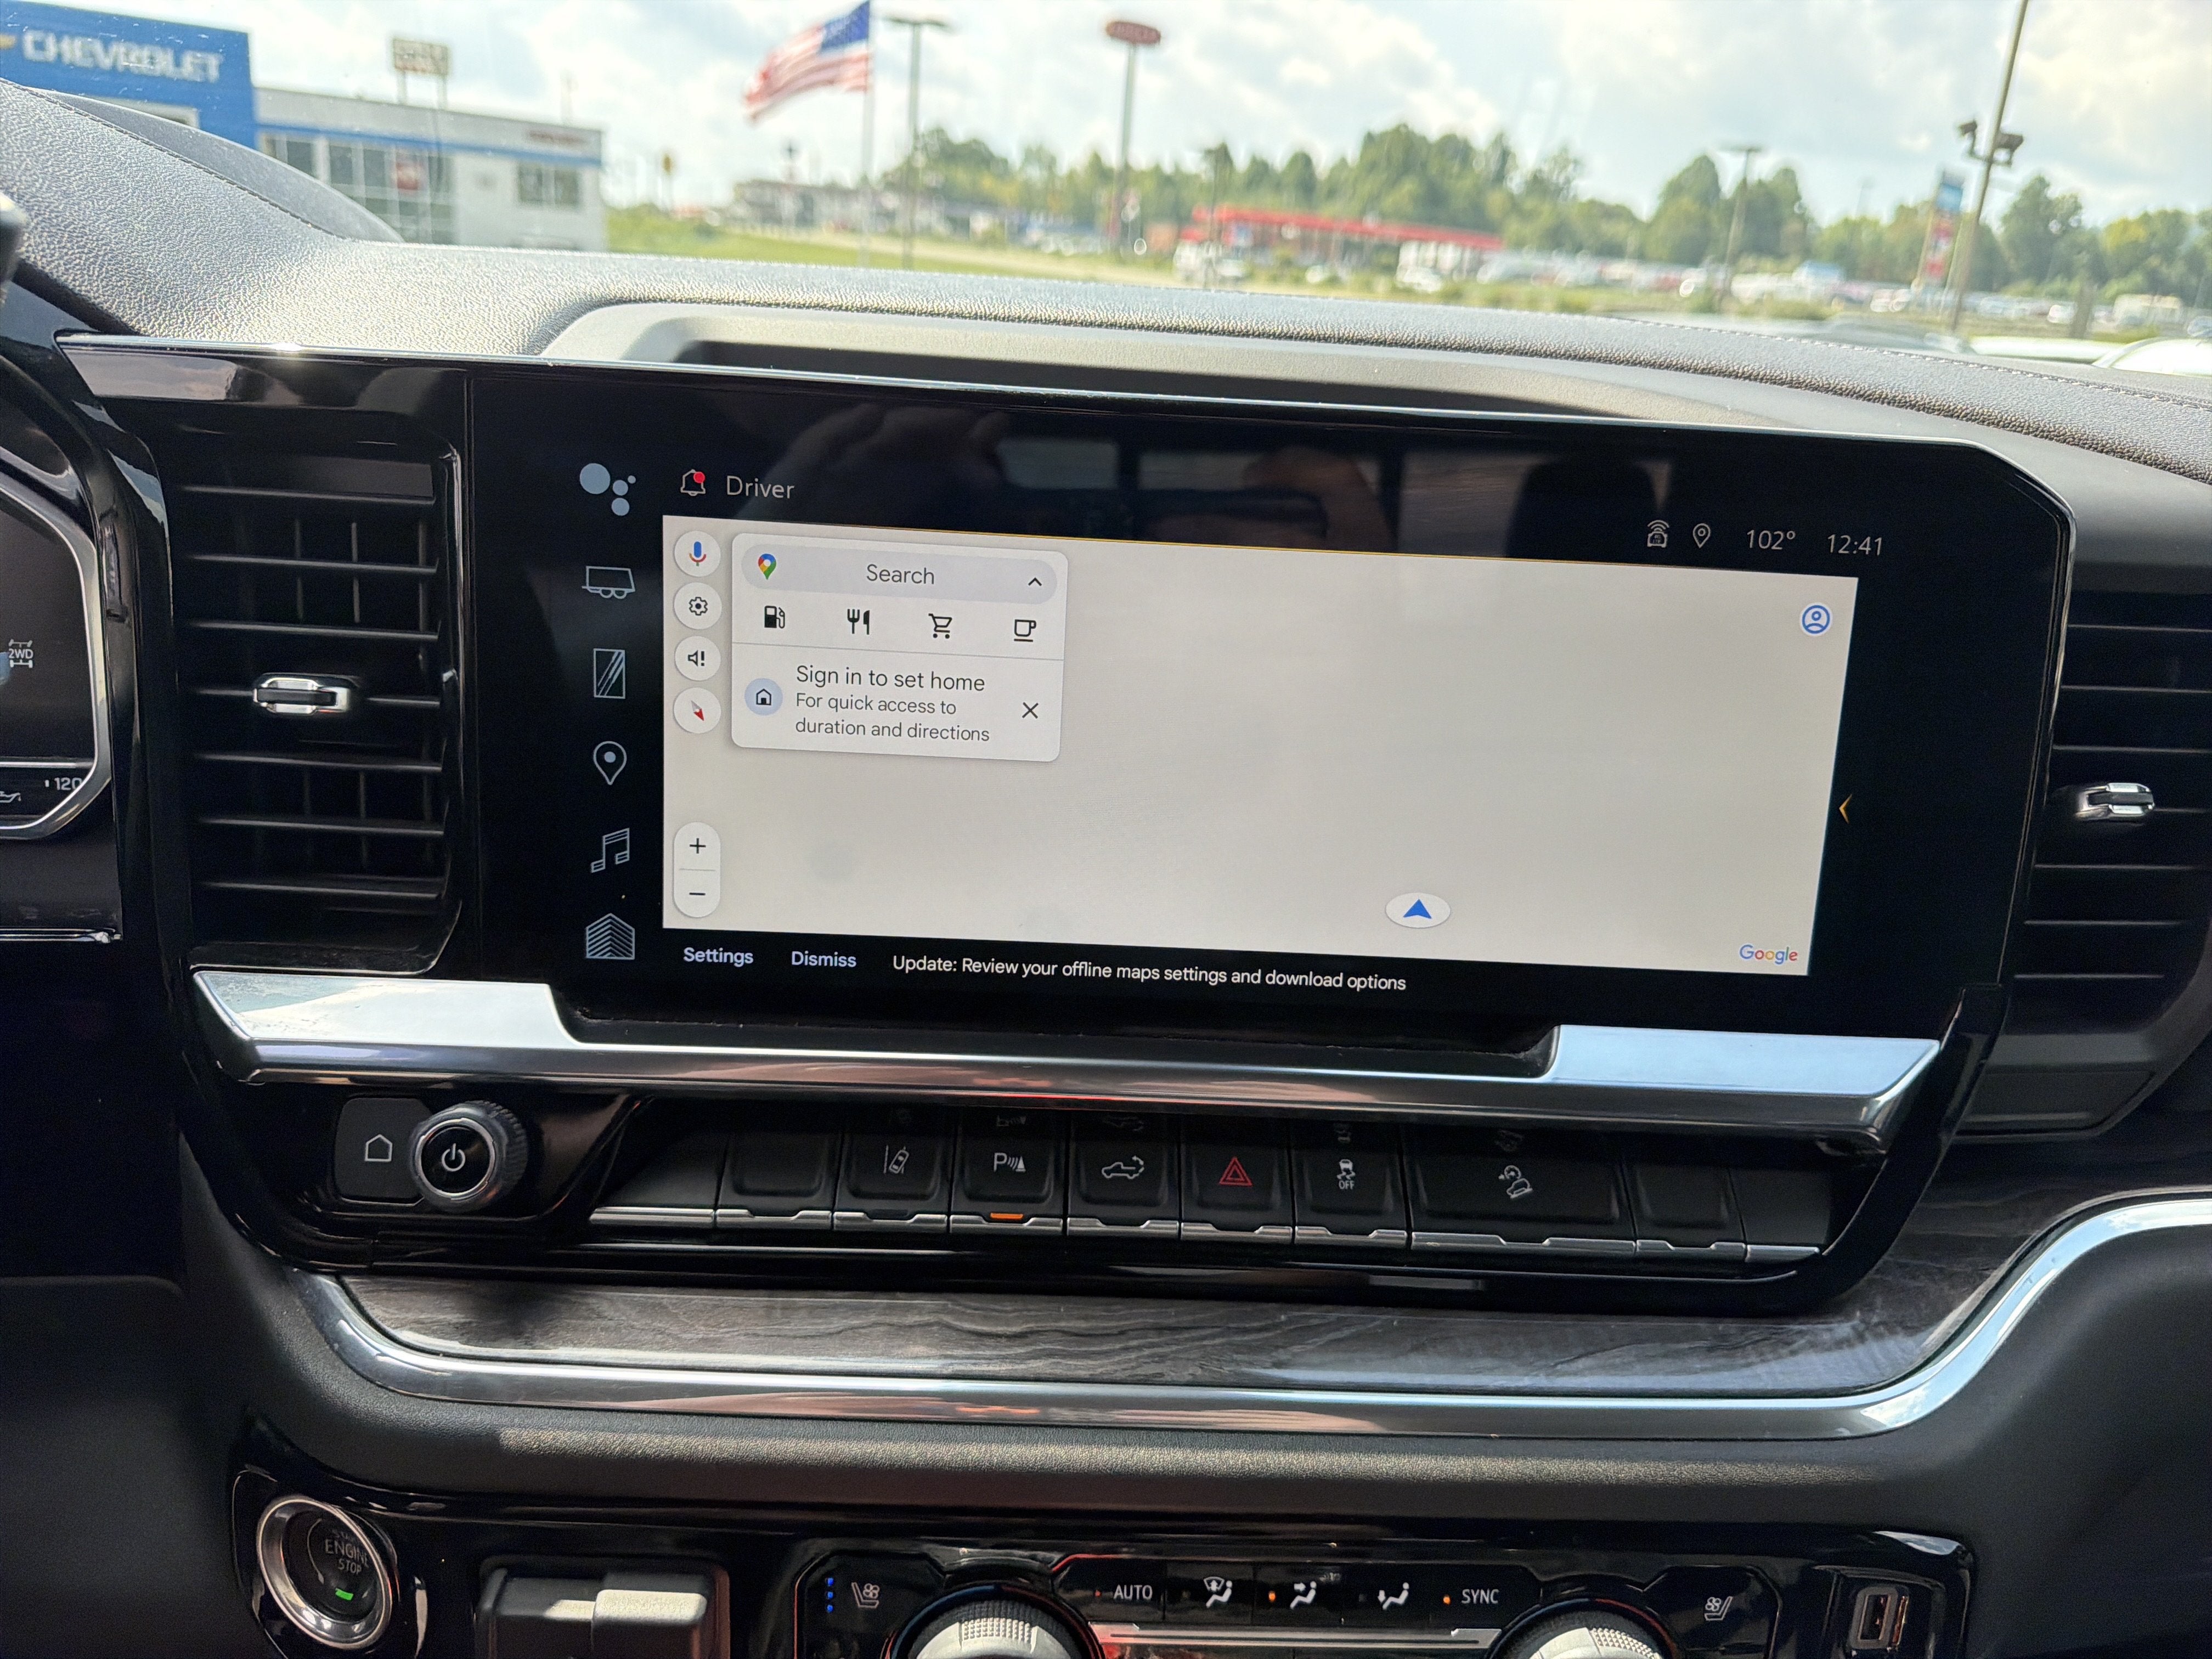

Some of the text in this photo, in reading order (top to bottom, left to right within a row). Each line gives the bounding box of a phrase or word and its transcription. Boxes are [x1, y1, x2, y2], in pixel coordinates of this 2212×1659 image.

[22, 30, 222, 83] CHEVROLET
[727, 475, 795, 499] Driver
[1827, 534, 1882, 556] 12:41
[866, 563, 934, 585] Search
[8, 648, 33, 659] 2WD
[797, 664, 985, 691] Sign in to set home
[797, 692, 956, 715] For quick access to
[795, 717, 990, 742] duration and directions
[683, 947, 754, 968] Settings
[792, 950, 857, 968] Dismiss
[1739, 944, 1798, 964] Google
[893, 955, 1406, 992] Update: Review your offline maps settings and download options
[1339, 1180, 1355, 1189] OFF
[338, 1558, 362, 1575] STOP
[1113, 1584, 1153, 1600] AUTO
[1461, 1588, 1499, 1604] SYNC
